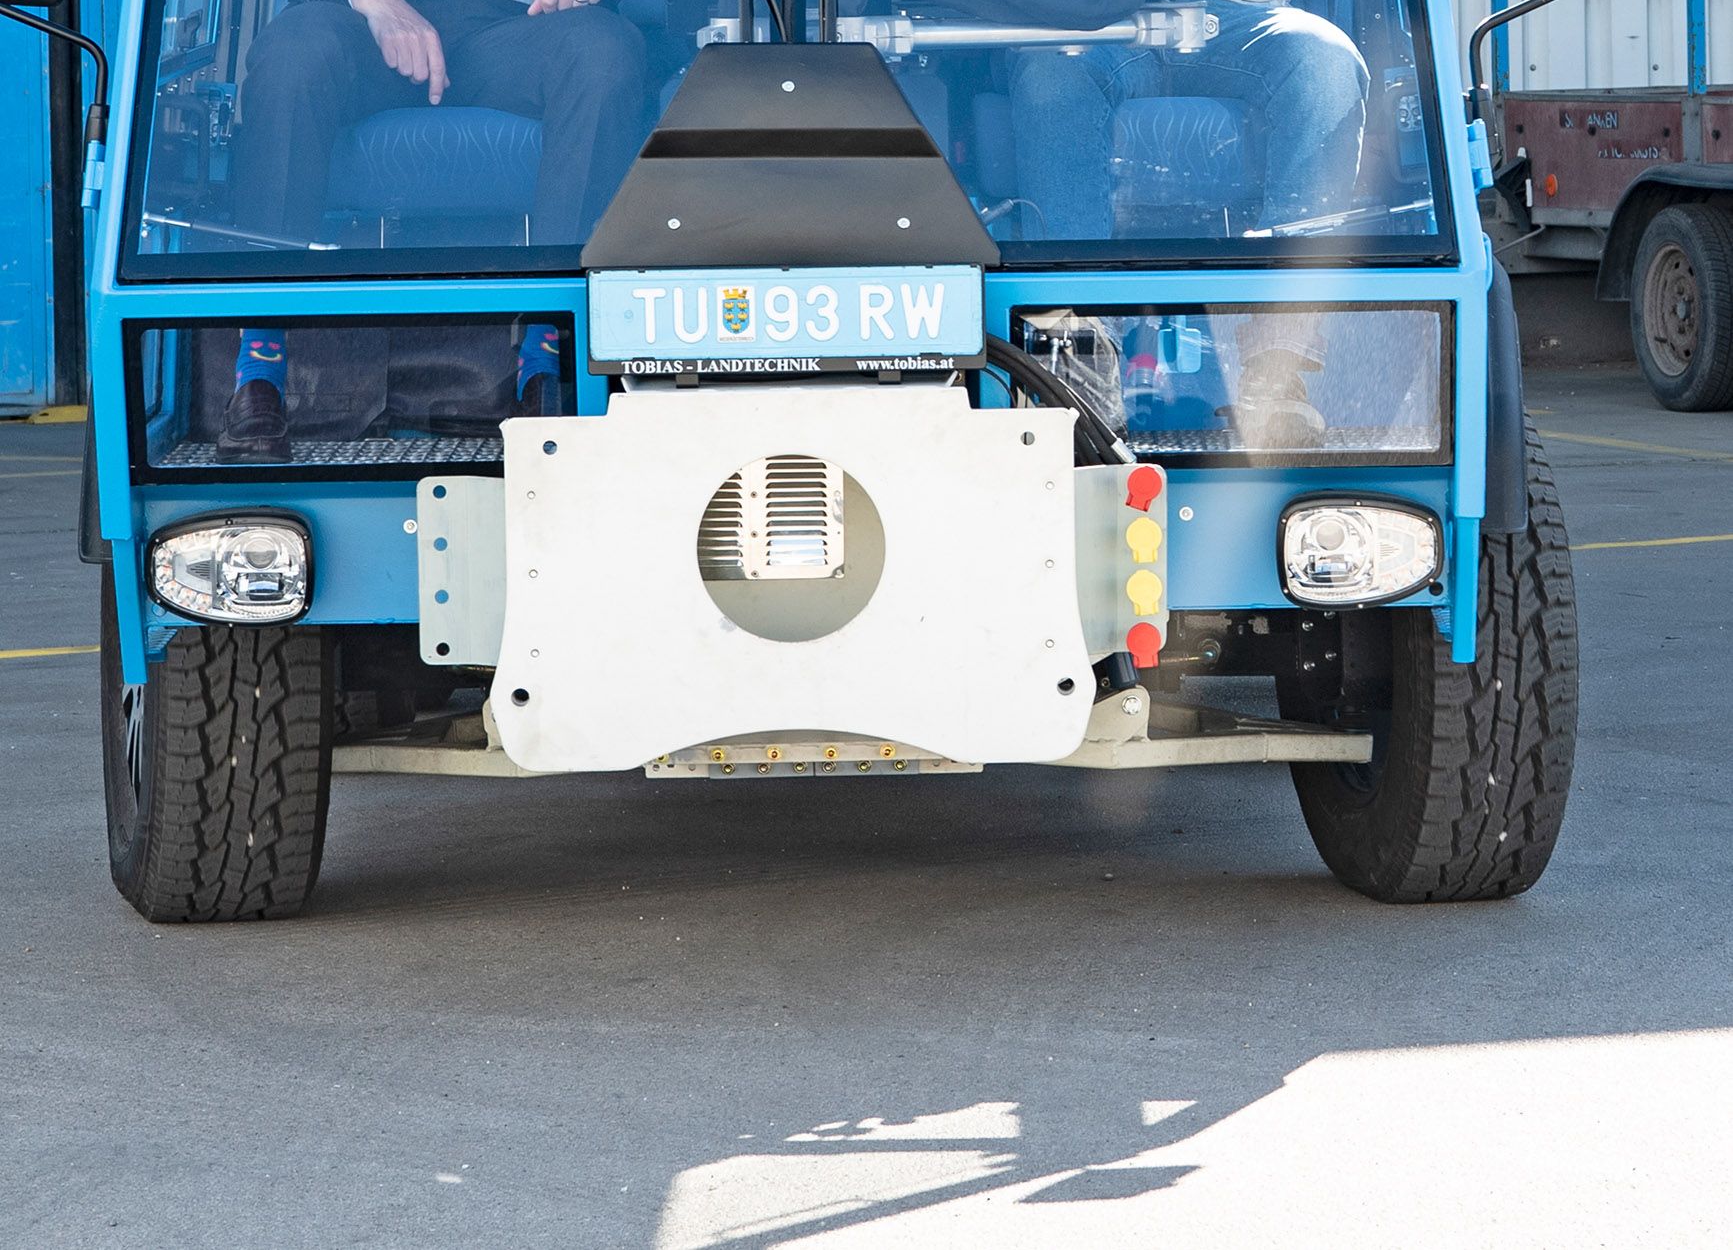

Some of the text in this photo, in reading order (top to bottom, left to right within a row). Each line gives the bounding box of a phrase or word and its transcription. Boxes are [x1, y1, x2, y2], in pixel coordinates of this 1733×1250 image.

[632, 283, 945, 344] TU 93 RW
[621, 360, 683, 374] TOBIAS
[697, 358, 821, 373] LANDTECHNIK
[856, 356, 955, 370] www.tobias.at
